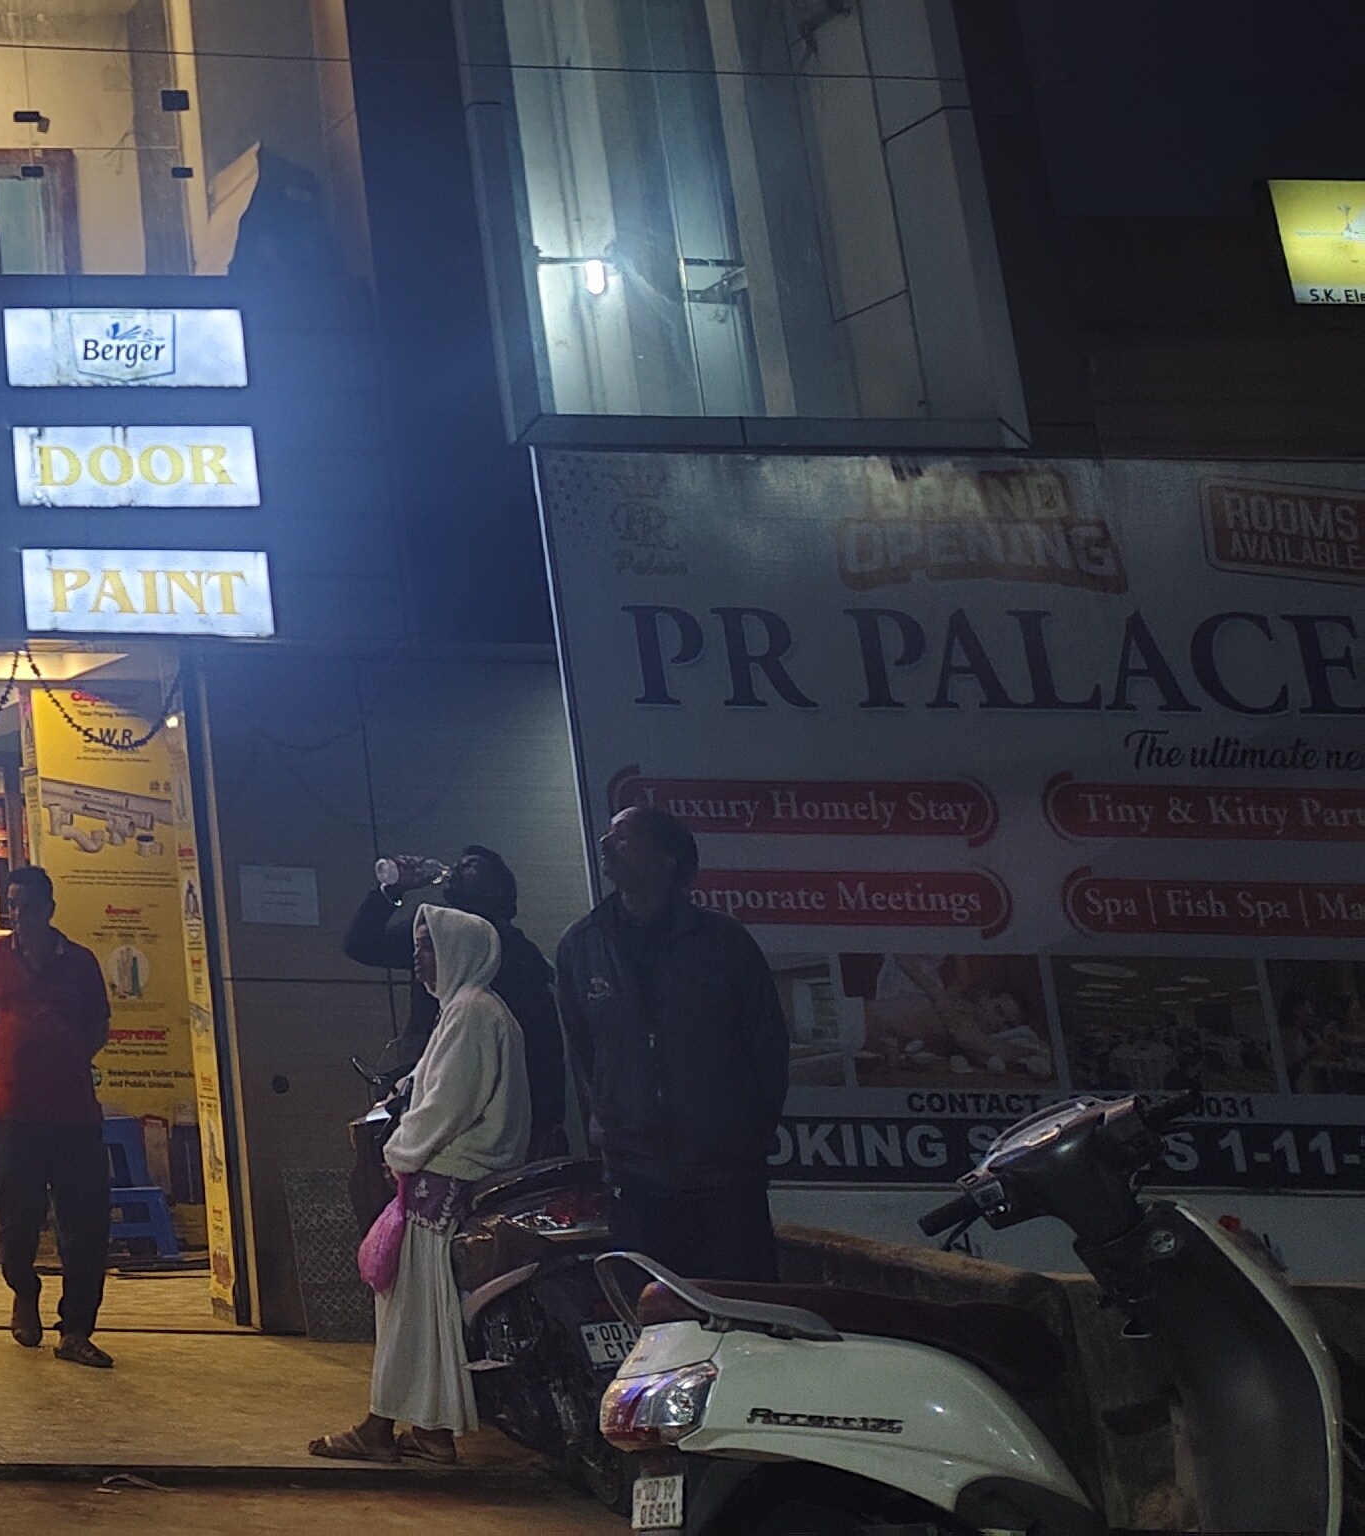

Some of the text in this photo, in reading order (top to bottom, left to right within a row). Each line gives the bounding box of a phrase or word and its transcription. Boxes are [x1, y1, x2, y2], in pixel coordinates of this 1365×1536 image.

[82, 338, 166, 369] Berger
[36, 443, 238, 487] DOOR
[1224, 492, 1360, 542] ROOMS
[47, 568, 249, 616] PAINT
[620, 605, 1365, 715] PR PALACE
[1124, 729, 1186, 770] The
[1189, 736, 1320, 771] ultimate
[769, 789, 896, 829] Homely
[905, 791, 974, 830] Stay
[1078, 793, 1153, 833] Tiny
[1167, 796, 1198, 825] &
[1205, 795, 1290, 835] Kitty
[689, 881, 981, 922] orporate Meetings
[1084, 888, 1138, 924] Spa
[1165, 889, 1227, 918] Fish
[1235, 891, 1292, 928] Spa
[906, 1092, 1039, 1116] CONTACT
